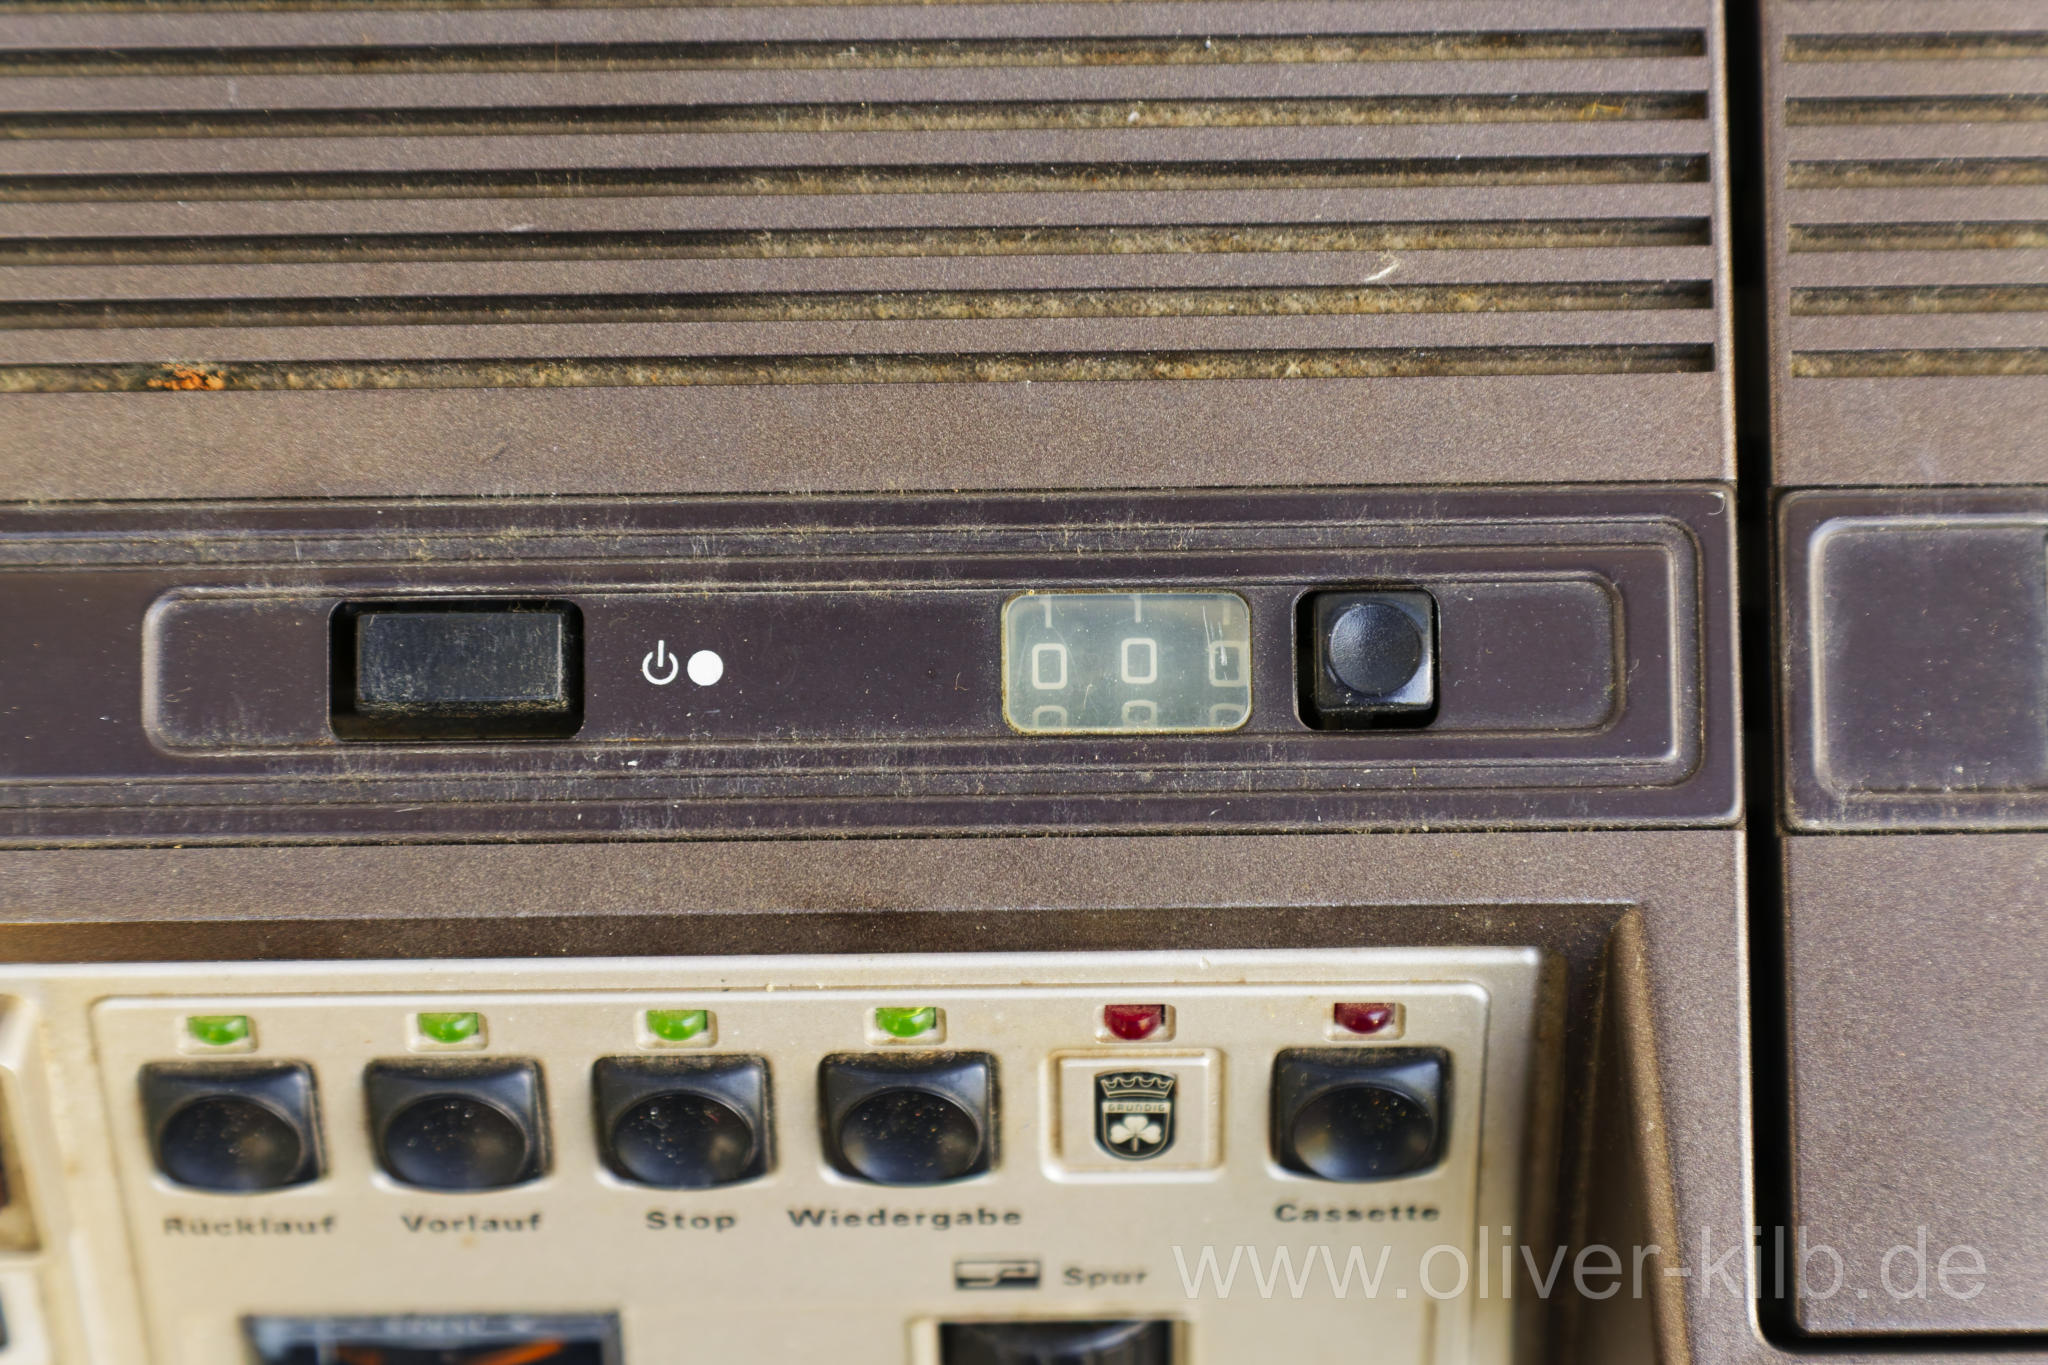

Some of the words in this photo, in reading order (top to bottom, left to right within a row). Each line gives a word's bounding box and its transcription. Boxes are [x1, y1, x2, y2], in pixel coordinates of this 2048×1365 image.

[1107, 1103, 1166, 1112] GRUNDIG
[647, 1211, 737, 1233] Stop
[788, 1209, 1022, 1230] Wiedergabe
[1274, 1202, 1440, 1223] Cassette
[163, 1216, 337, 1237] Rücklauf
[402, 1213, 541, 1234] Vorlauf
[1062, 1266, 1148, 1288] Spur
